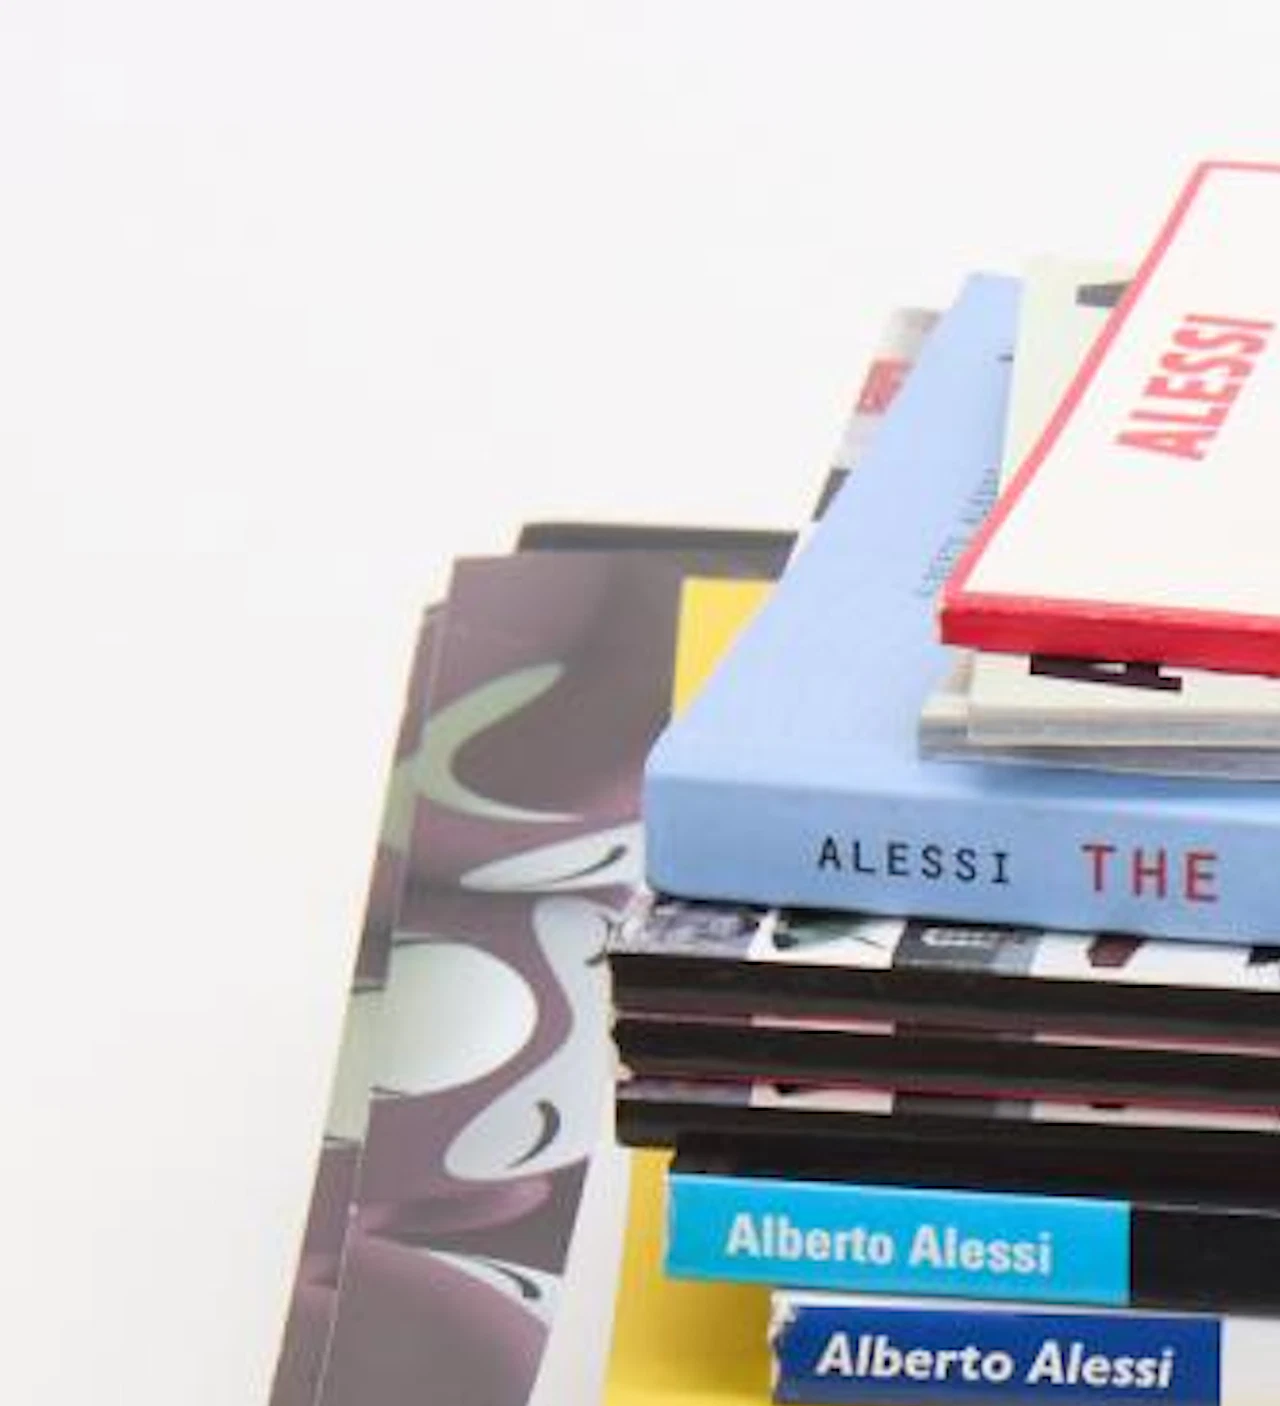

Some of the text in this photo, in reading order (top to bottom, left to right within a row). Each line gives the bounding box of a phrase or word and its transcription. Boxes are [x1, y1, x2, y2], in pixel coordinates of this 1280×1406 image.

[1115, 314, 1277, 462] ALESSI
[816, 835, 1011, 887] ALESSI
[1081, 843, 1219, 903] THE
[725, 1212, 894, 1266] Alberto
[908, 1224, 1053, 1276] Alessi
[815, 1331, 1014, 1384] Alberto
[1026, 1341, 1176, 1389] Alessi
